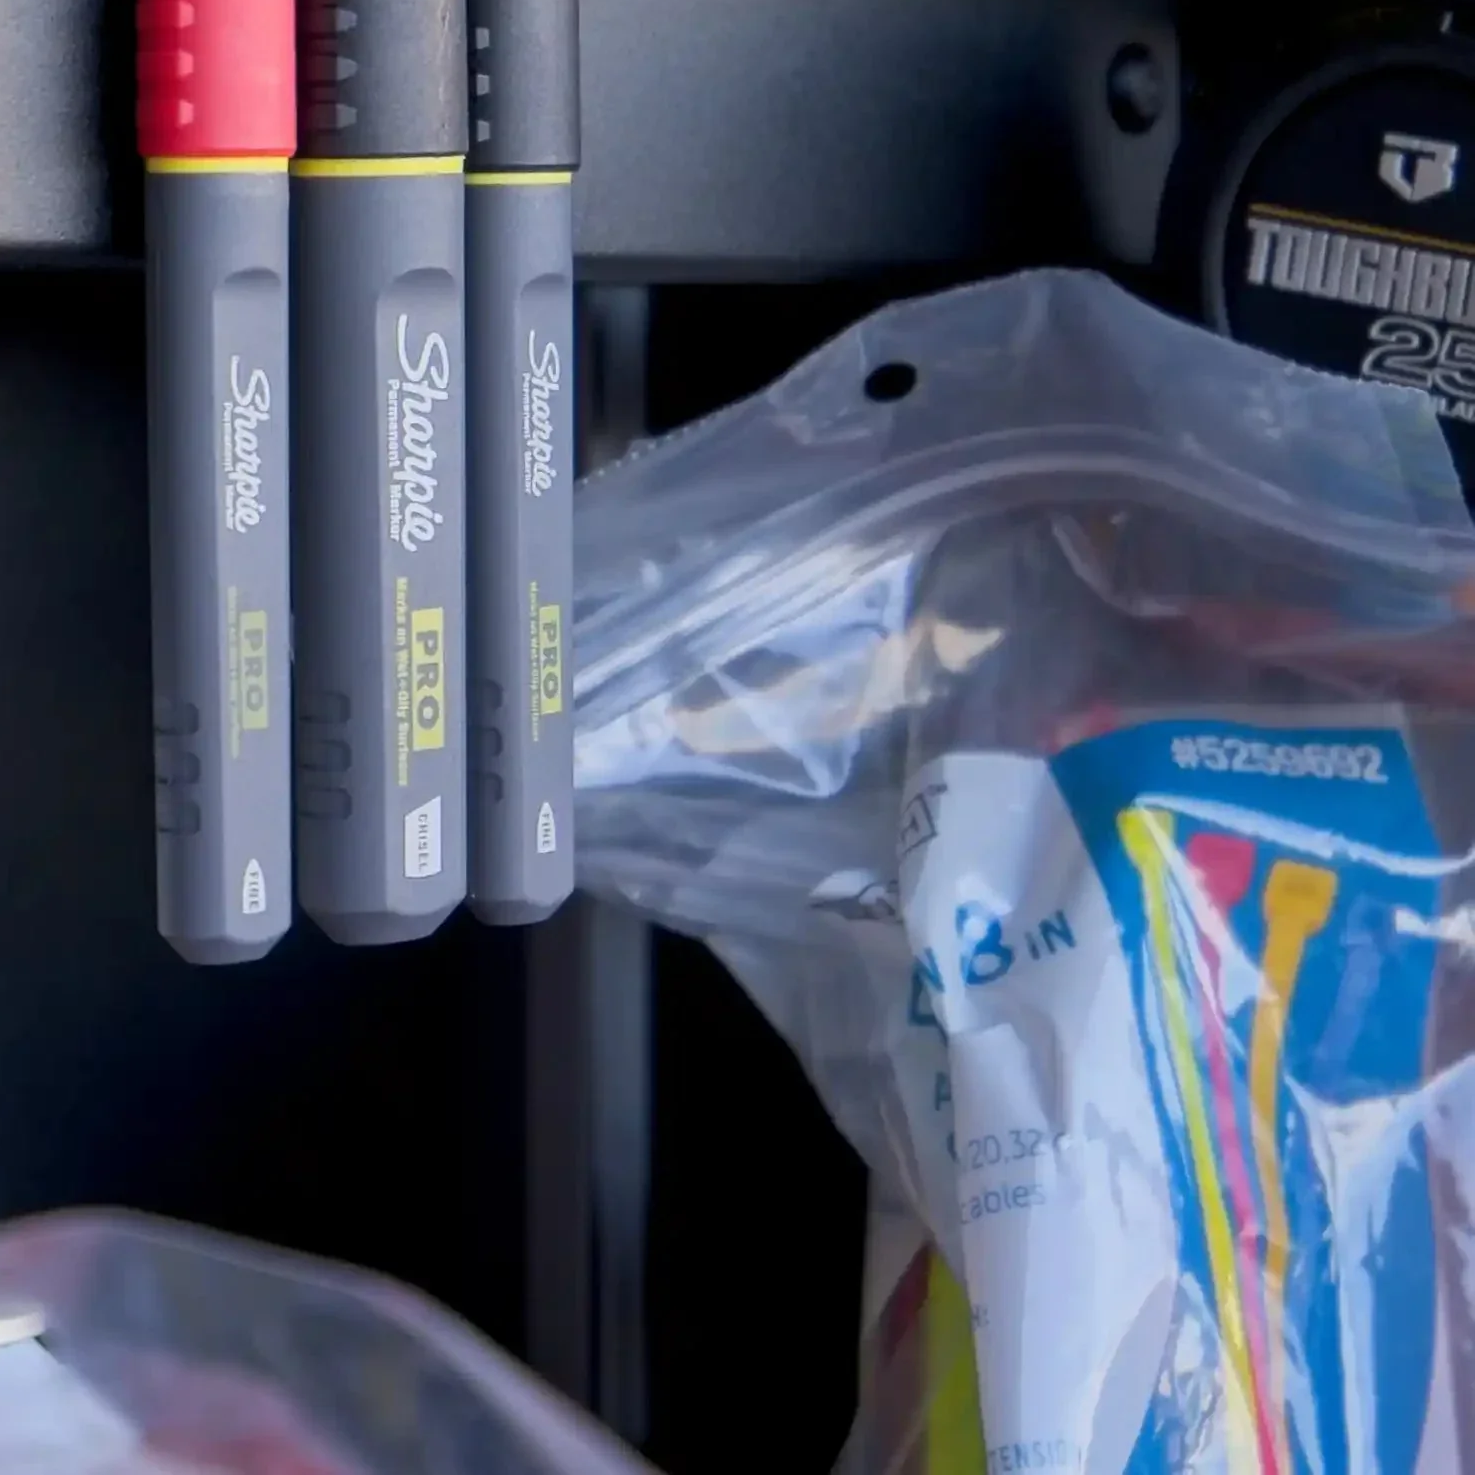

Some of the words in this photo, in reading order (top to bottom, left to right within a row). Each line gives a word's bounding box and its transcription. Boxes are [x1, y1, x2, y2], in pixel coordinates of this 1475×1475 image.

[228, 355, 271, 534] Sharpie
[387, 379, 401, 468] Permanent
[393, 313, 450, 552] Sharpie
[526, 329, 561, 498] Sharpie
[243, 628, 264, 712] PRO
[416, 629, 440, 731] PRO
[542, 617, 559, 700] PRO
